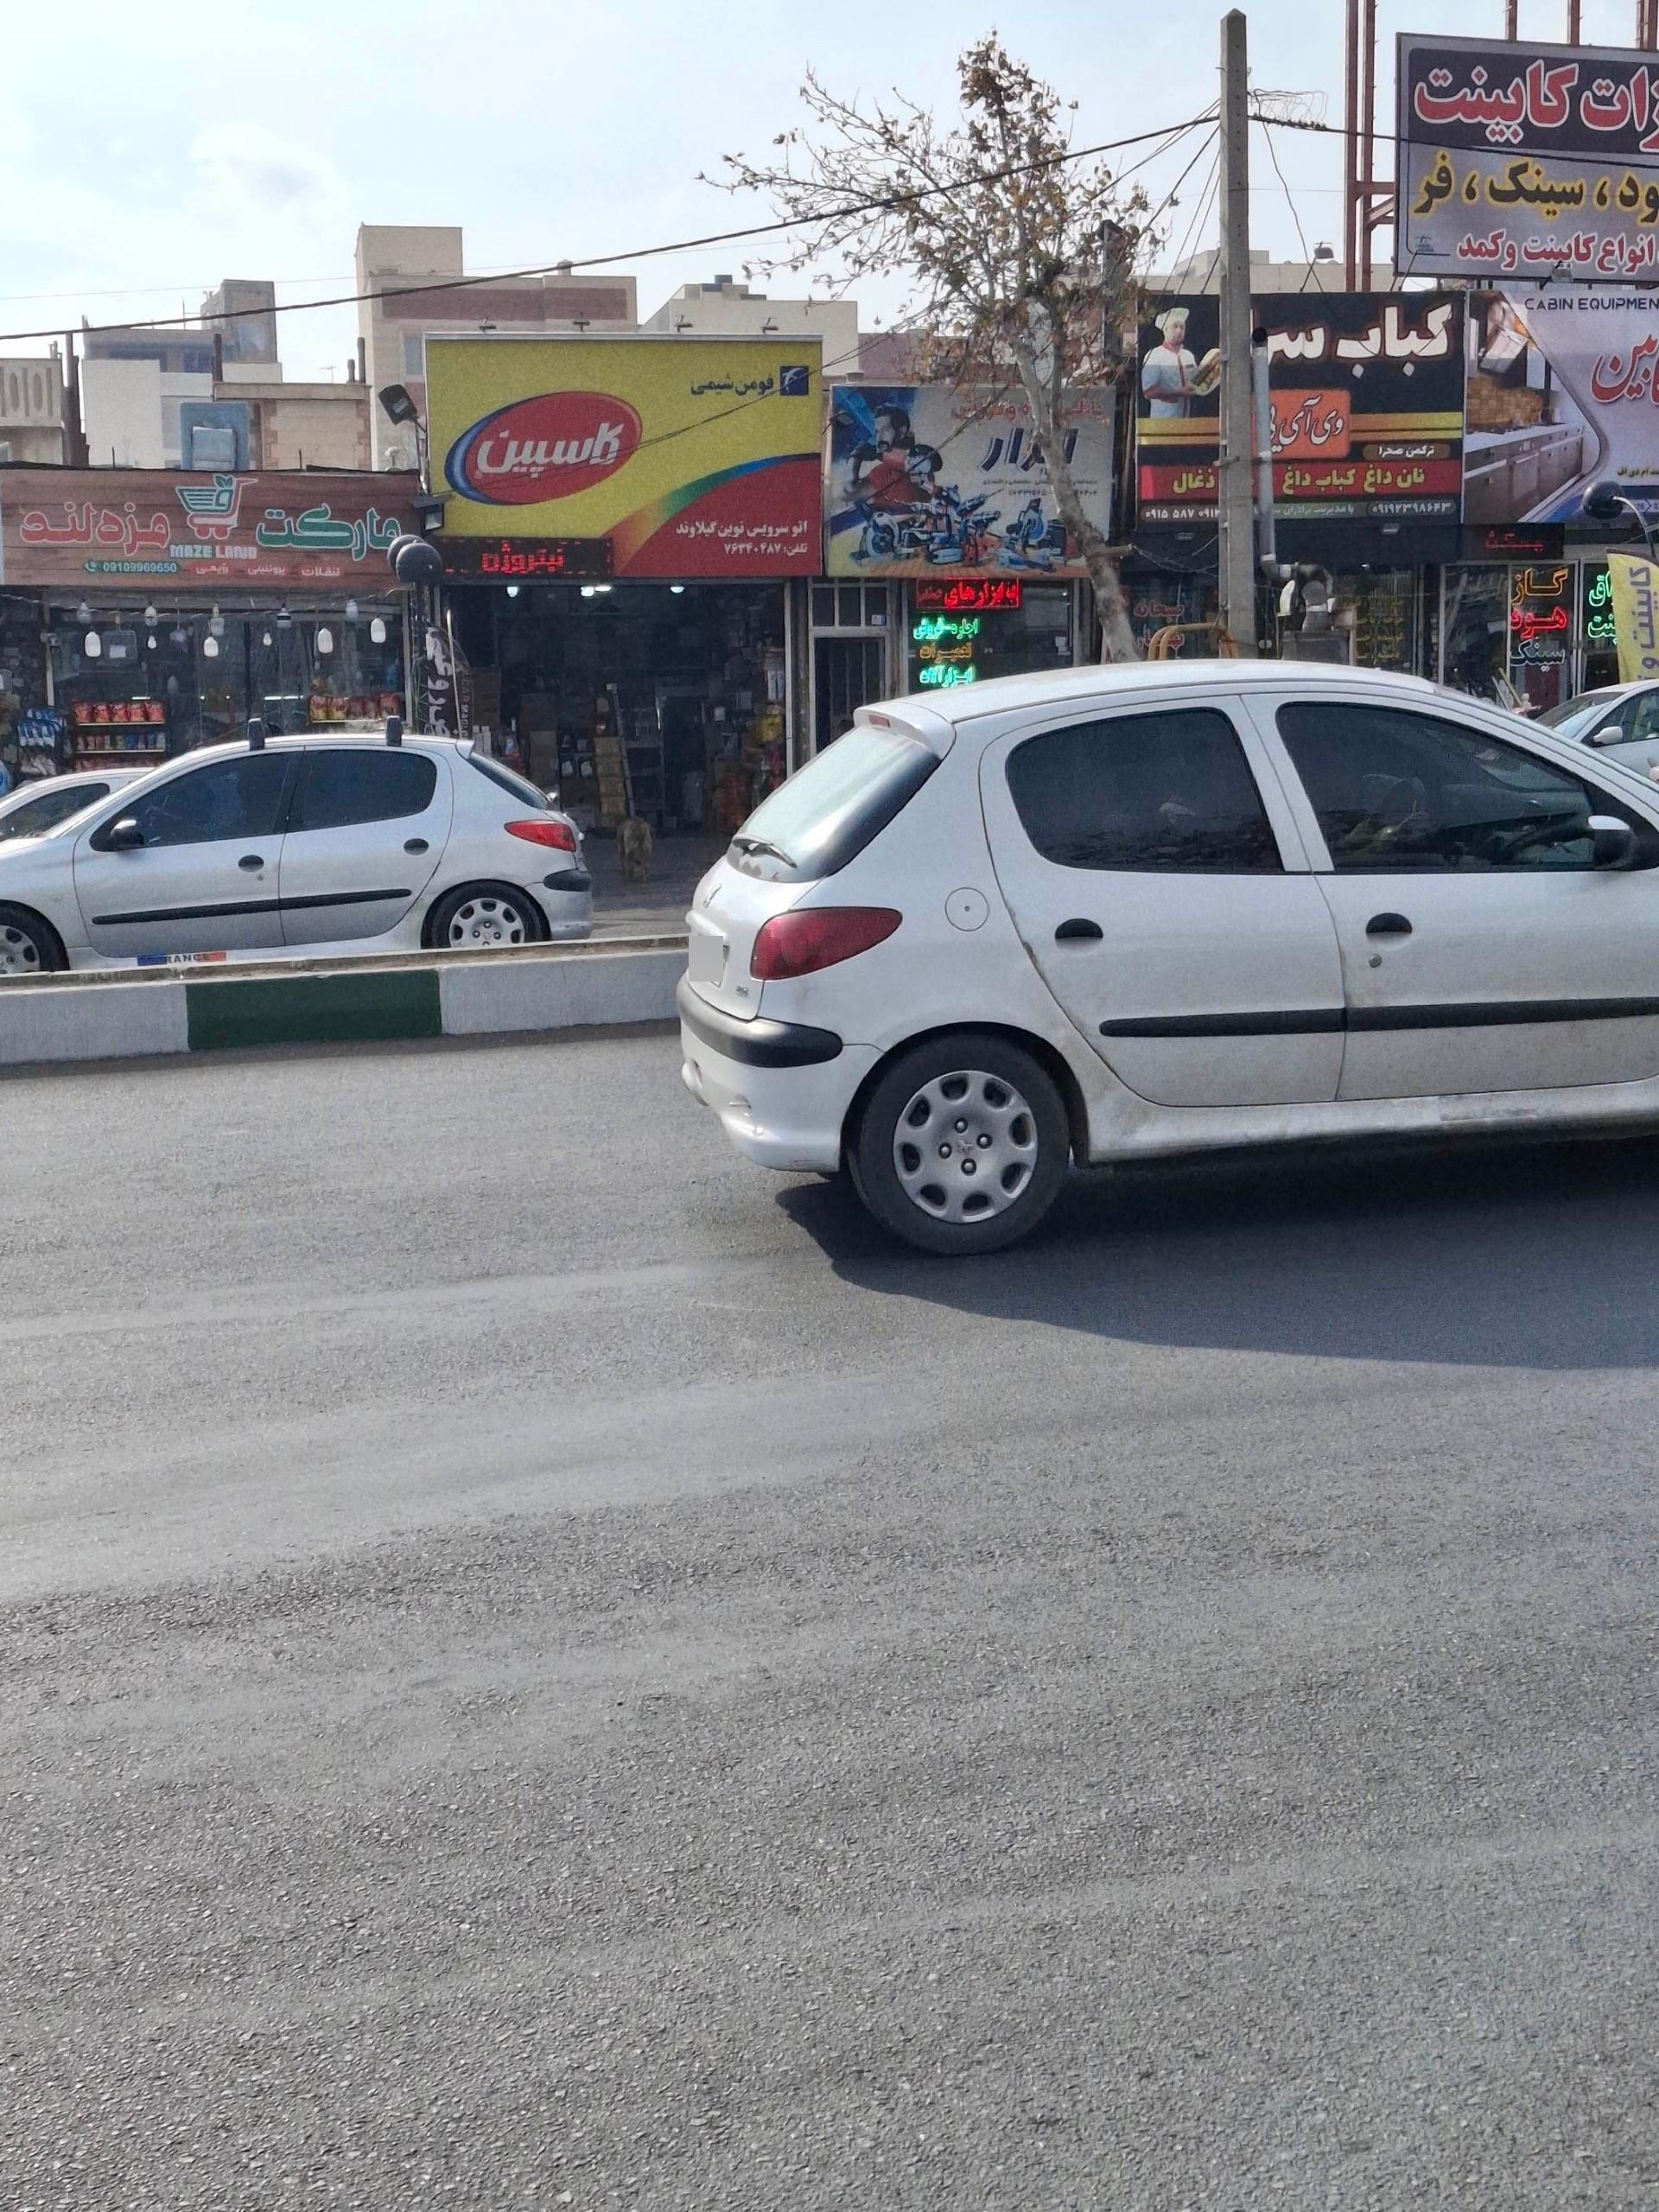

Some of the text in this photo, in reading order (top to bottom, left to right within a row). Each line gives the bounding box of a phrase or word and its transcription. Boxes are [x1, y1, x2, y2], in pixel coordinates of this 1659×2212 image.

[1414, 59, 1580, 144] کابینت
[1413, 152, 1453, 213] فر
[1522, 232, 1597, 267] کابینت
[1597, 232, 1655, 273] انواع
[1525, 296, 1659, 310] CABIN EQUIPMEN
[1249, 302, 1452, 379] کباب سر
[691, 372, 774, 396] فومن شیمی
[1279, 394, 1322, 446] آی
[1310, 409, 1344, 445] وی
[475, 422, 624, 478] کاسپین
[1378, 445, 1435, 458] ترکمن صحرا
[1173, 463, 1426, 495] نان داغ کباب داغ ذغال
[676, 519, 808, 538] اتو سرویس نوین گیلاوند
[1173, 507, 1195, 518] ۵۸۷
[256, 503, 401, 561] مارکت
[169, 544, 257, 559] MAZE LAND
[482, 542, 564, 574] نیتروژن
[195, 563, 229, 575] رژیمی
[301, 565, 340, 576] تنقلات
[1510, 568, 1569, 605] گاز
[1510, 605, 1569, 639] هود
[1629, 566, 1659, 650] کابینت
[919, 641, 973, 664] تعمیرات
[1510, 639, 1566, 672] سینک
[157, 953, 210, 963] RANCE
